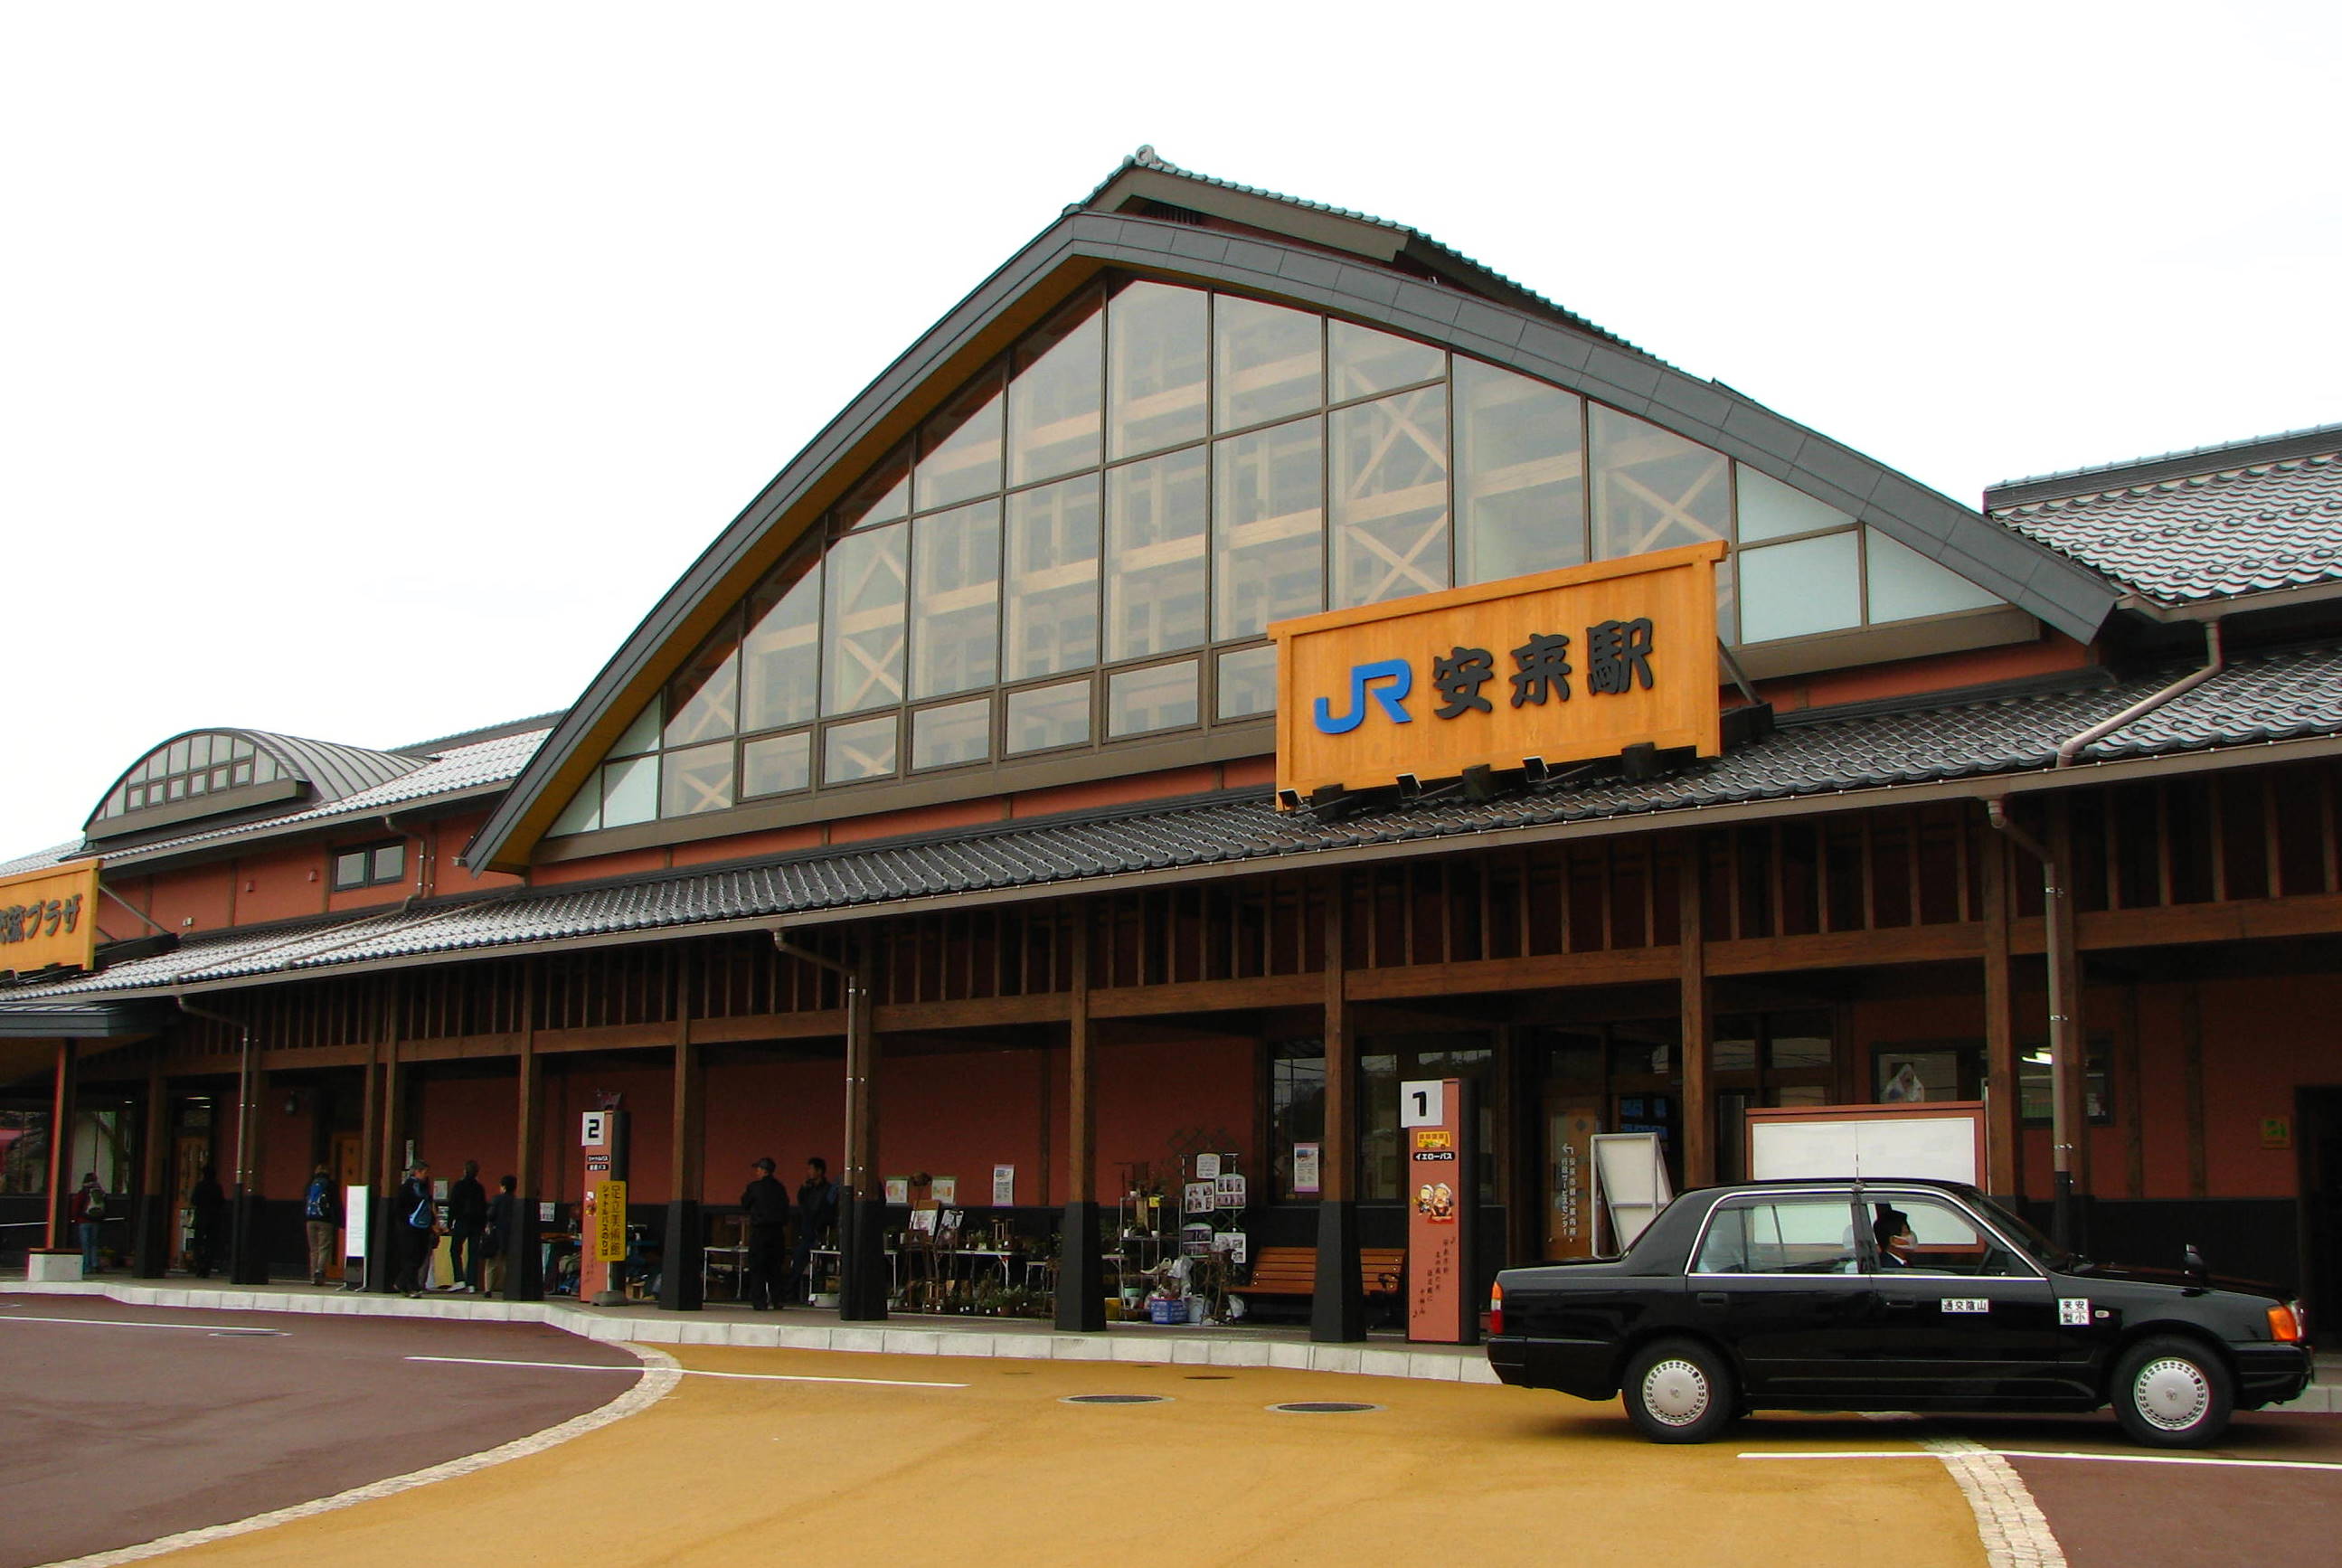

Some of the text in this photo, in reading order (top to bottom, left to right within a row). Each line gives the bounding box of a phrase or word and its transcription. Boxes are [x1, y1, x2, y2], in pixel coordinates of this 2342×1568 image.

[1314, 618, 1654, 734] JR 安来駅
[1412, 1091, 1427, 1117] 1
[589, 1119, 600, 1138] 2
